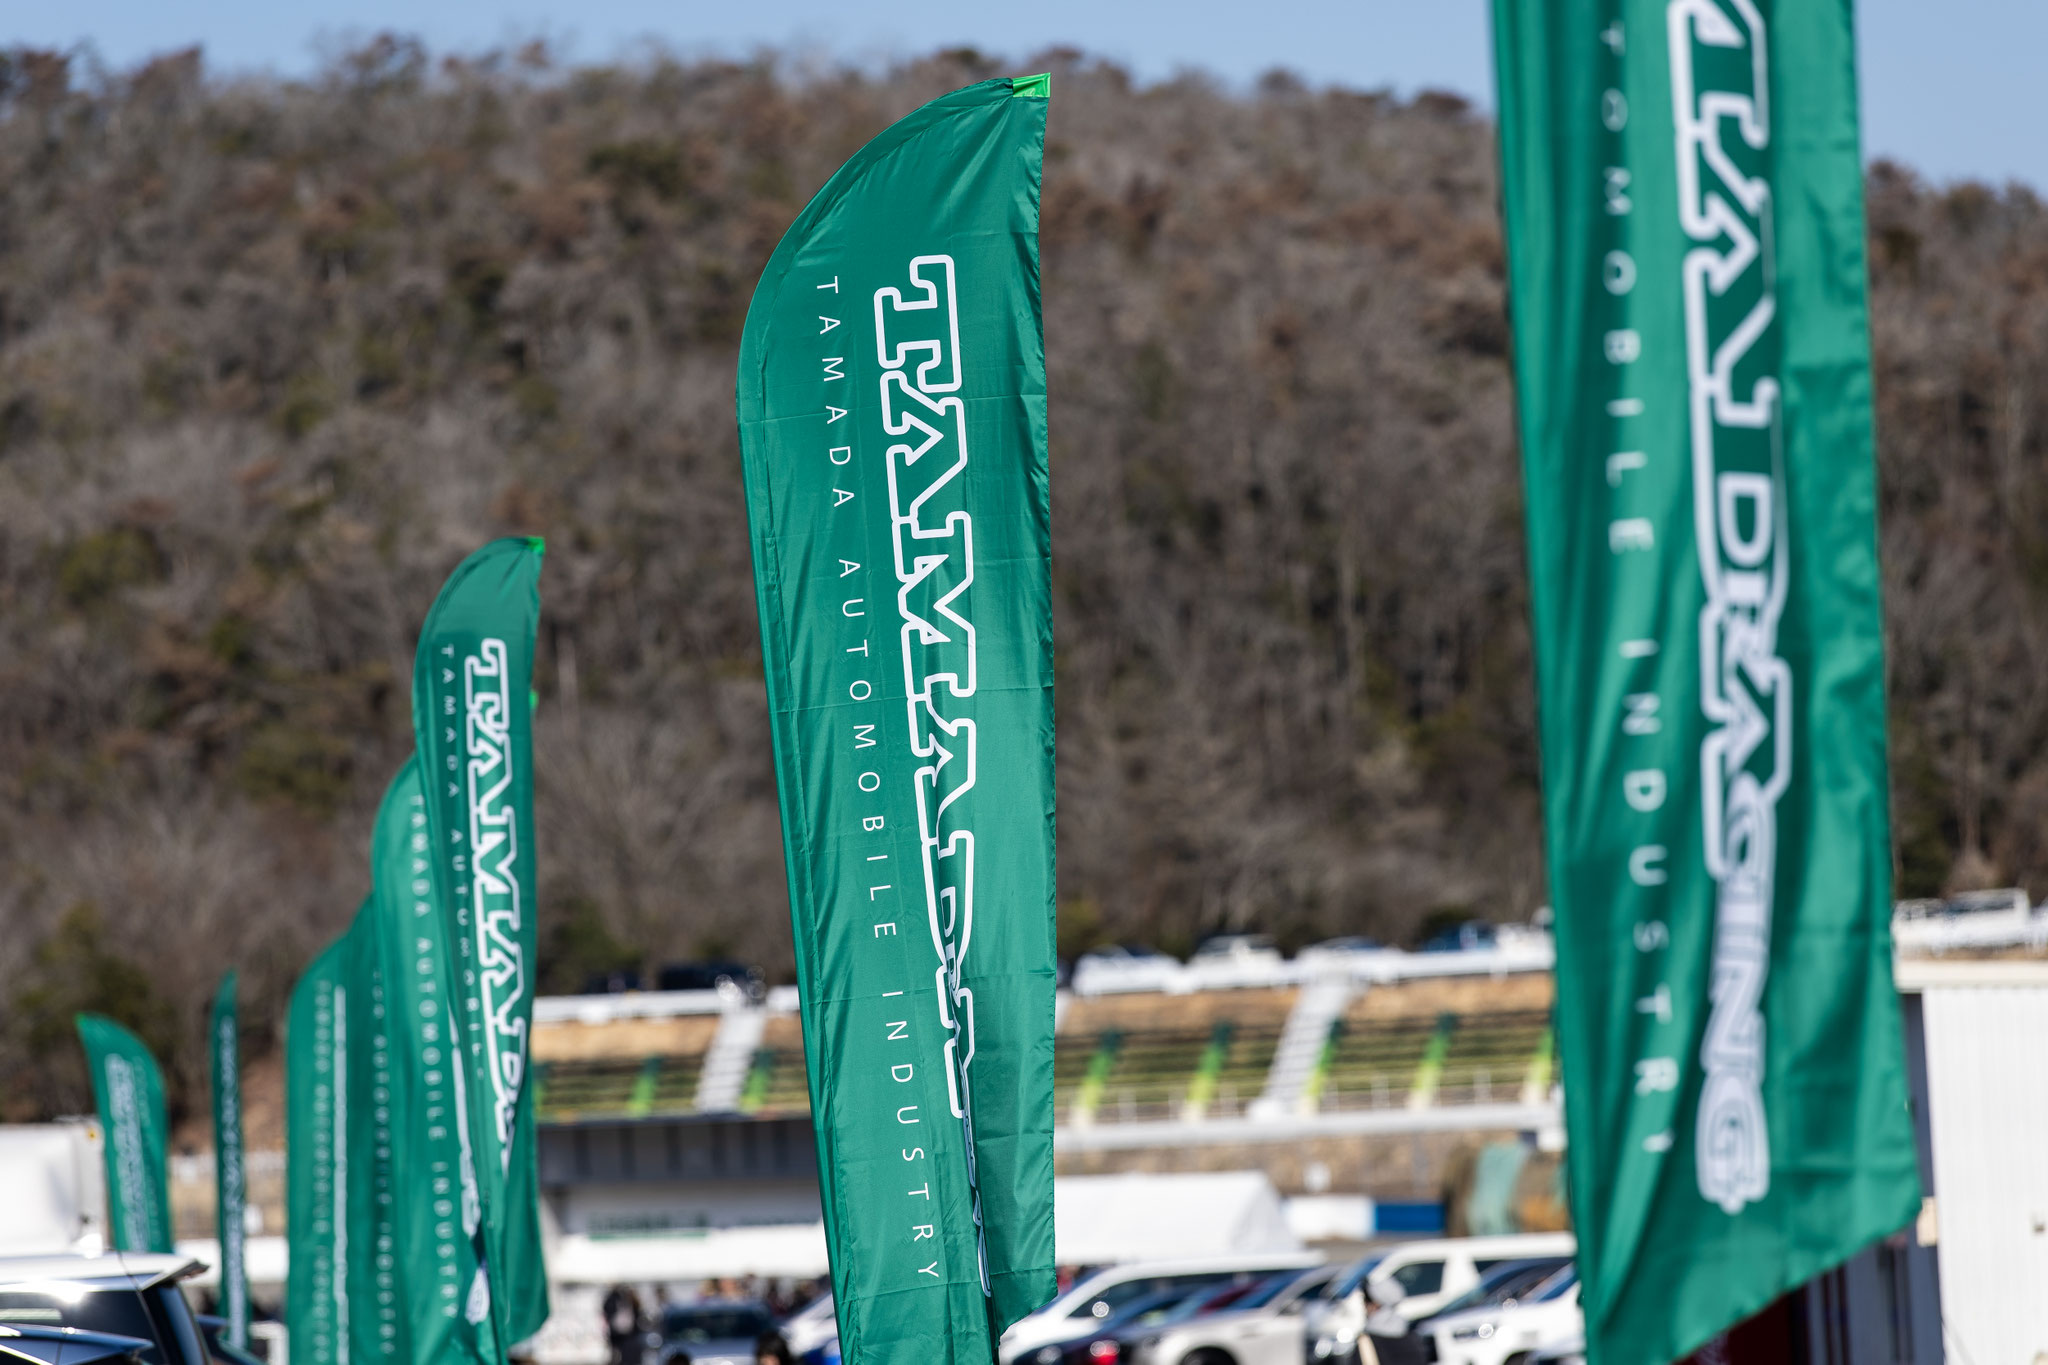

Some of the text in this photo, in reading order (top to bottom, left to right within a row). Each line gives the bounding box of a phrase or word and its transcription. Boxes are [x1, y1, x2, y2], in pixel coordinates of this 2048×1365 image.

[441, 643, 460, 798] TAMADA
[816, 275, 940, 1278] TAMADA AUTOMOBILE INDUSTRY
[416, 937, 447, 1140] AUTOMOBILE
[431, 1160, 459, 1319] INDUSTRY
